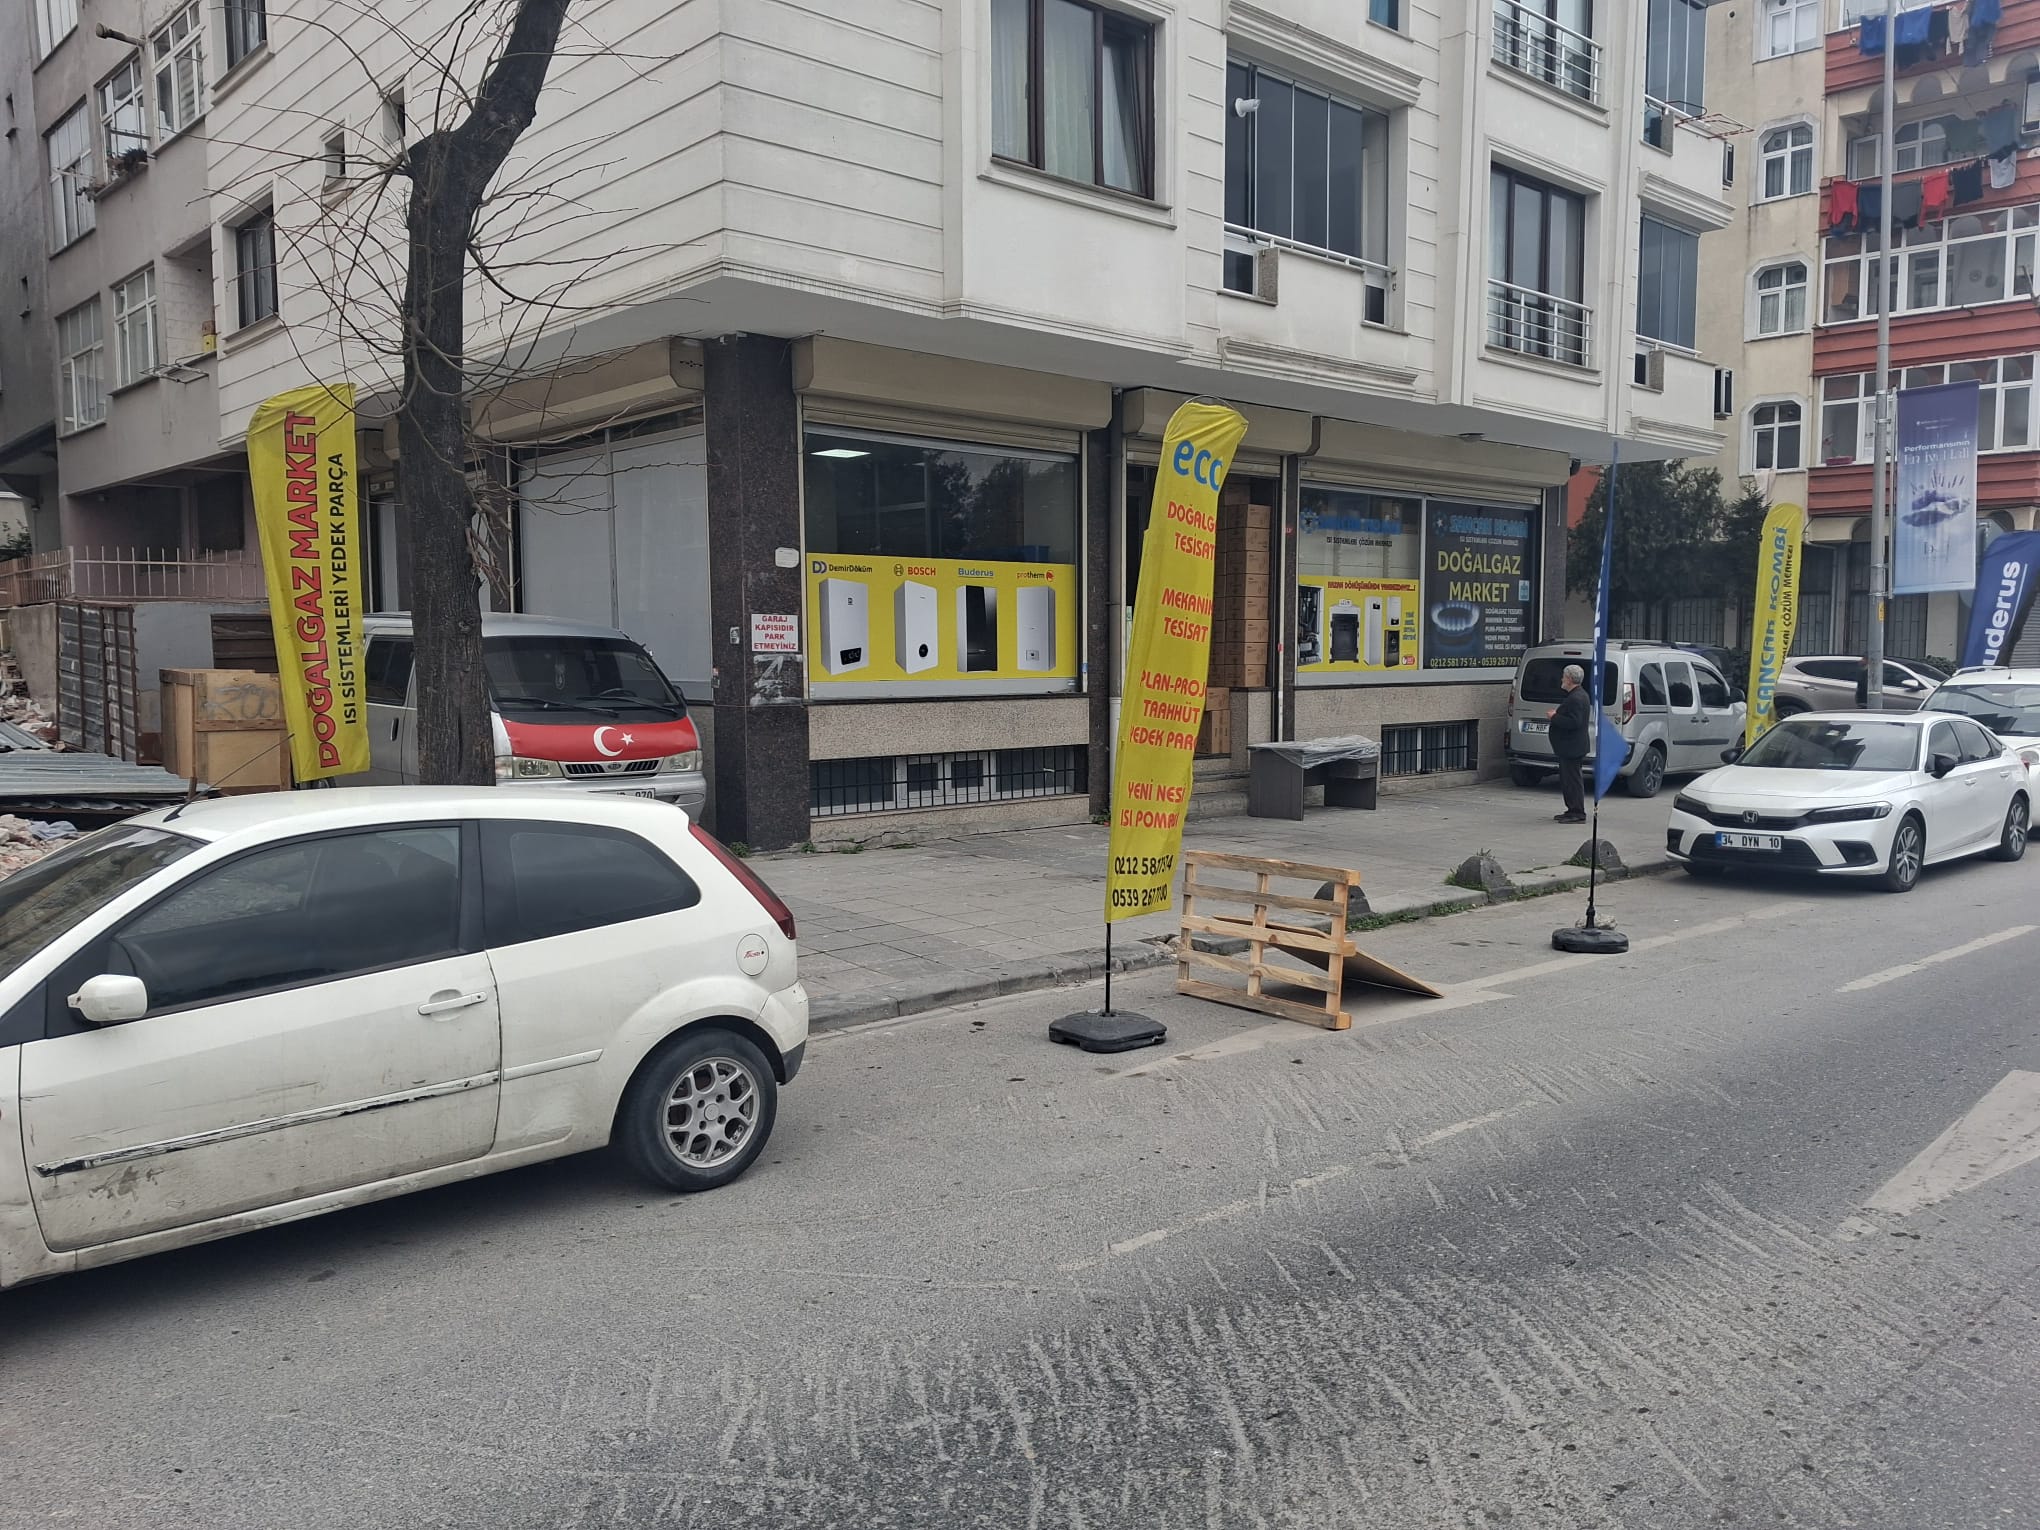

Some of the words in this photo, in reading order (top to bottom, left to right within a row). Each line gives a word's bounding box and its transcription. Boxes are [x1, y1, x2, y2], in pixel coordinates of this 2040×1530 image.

[284, 411, 321, 560] MARKET
[327, 453, 348, 517] PARÇA
[1167, 500, 1216, 533] DOĞALG
[330, 518, 348, 586] YEDEK
[1437, 547, 1521, 575] DOĞALGAZ
[828, 563, 873, 574] DemirDöküm
[907, 566, 936, 576] BOSCH
[957, 567, 994, 577] Buderus
[1016, 571, 1045, 579] protherm
[1449, 581, 1510, 602] MARKET
[762, 615, 788, 623] GARAJ
[1781, 590, 1792, 627] ÇÖZÜM
[754, 624, 794, 632] KAPISIDIR
[1163, 616, 1209, 643] TESİSAT
[332, 589, 357, 699] SİSTEMLERİ
[753, 642, 797, 650] ETMEYİNİZ
[291, 566, 342, 769] DOĞALGAZ
[1430, 657, 1446, 667] 0212
[1481, 657, 1497, 666] 0539
[344, 702, 357, 726] ISI
[1143, 699, 1201, 724] TAAHHÜT
[1128, 779, 1153, 800] YENİ
[1120, 809, 1133, 826] ISI
[1722, 835, 1733, 846] 34
[1741, 835, 1760, 847] DYN
[1768, 838, 1780, 848] 10
[1114, 856, 1138, 875] 0212
[1112, 889, 1139, 907] 0539
